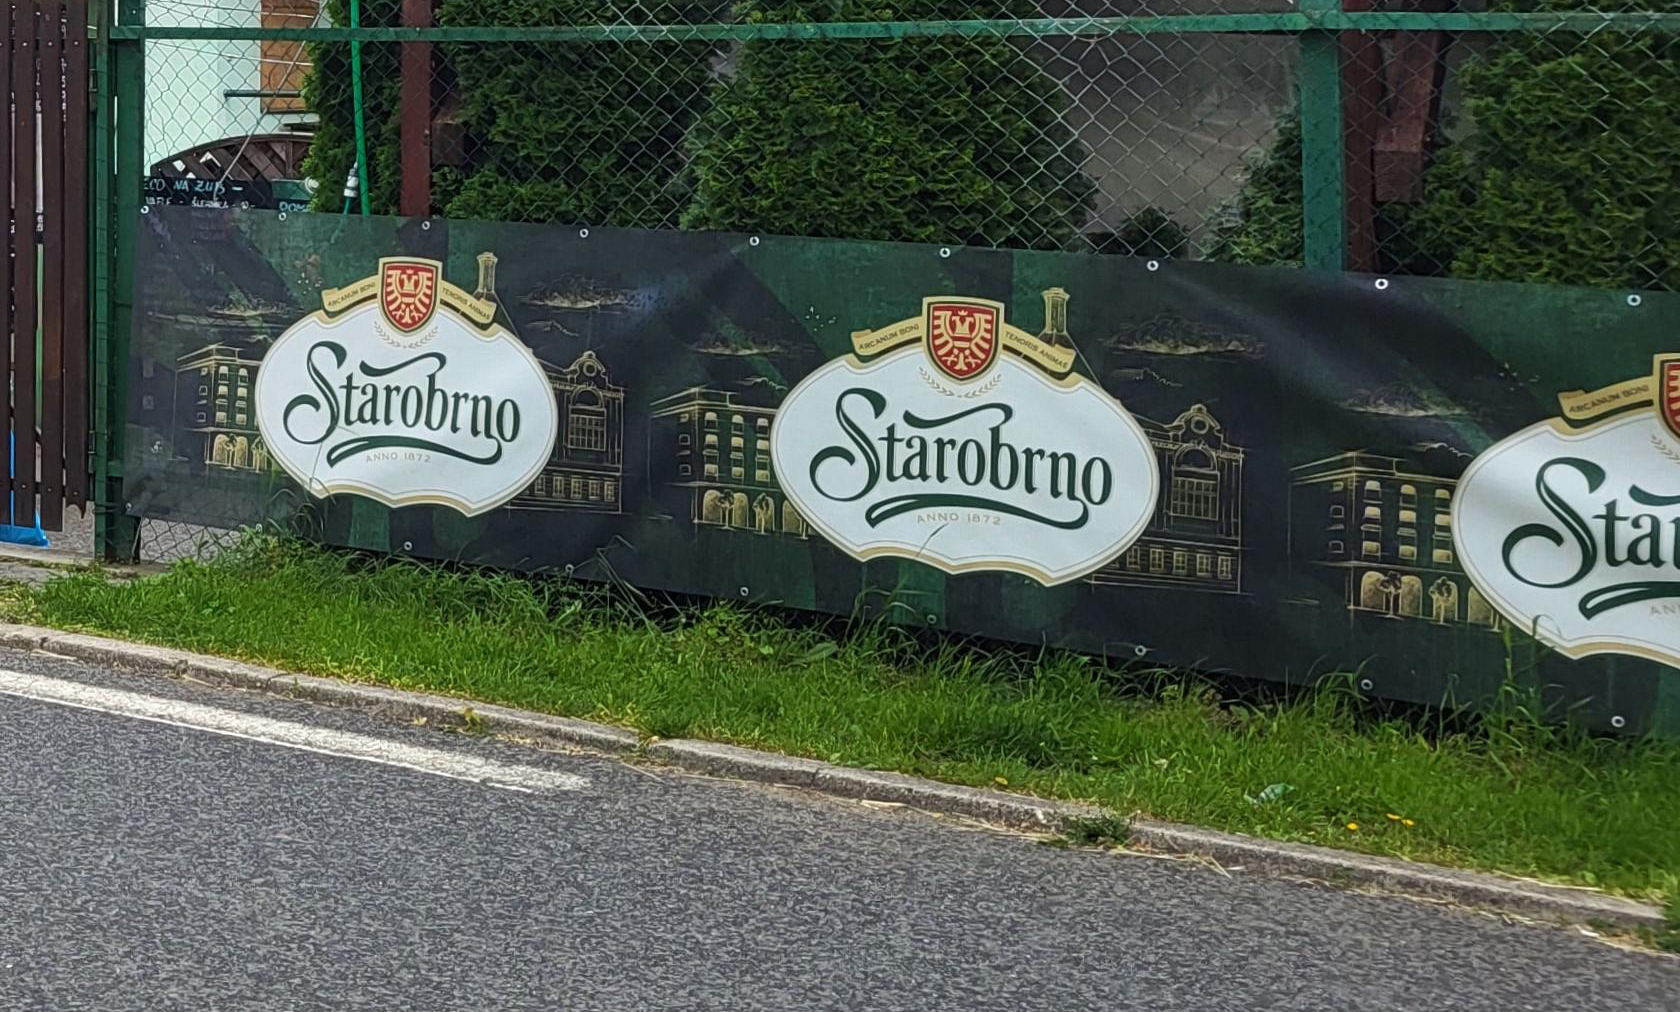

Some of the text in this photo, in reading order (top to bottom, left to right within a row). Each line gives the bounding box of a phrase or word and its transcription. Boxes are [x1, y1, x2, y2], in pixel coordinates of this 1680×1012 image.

[858, 323, 919, 351] ARCANUM BONI
[1005, 331, 1069, 369] TENORIS ANIMAE
[283, 340, 520, 467] Starobrno
[1569, 384, 1649, 413] ARCANUM BONI
[366, 452, 432, 463] ANNO 1872
[809, 387, 1113, 529] Starobrno
[917, 512, 1001, 525] ANNO 1872
